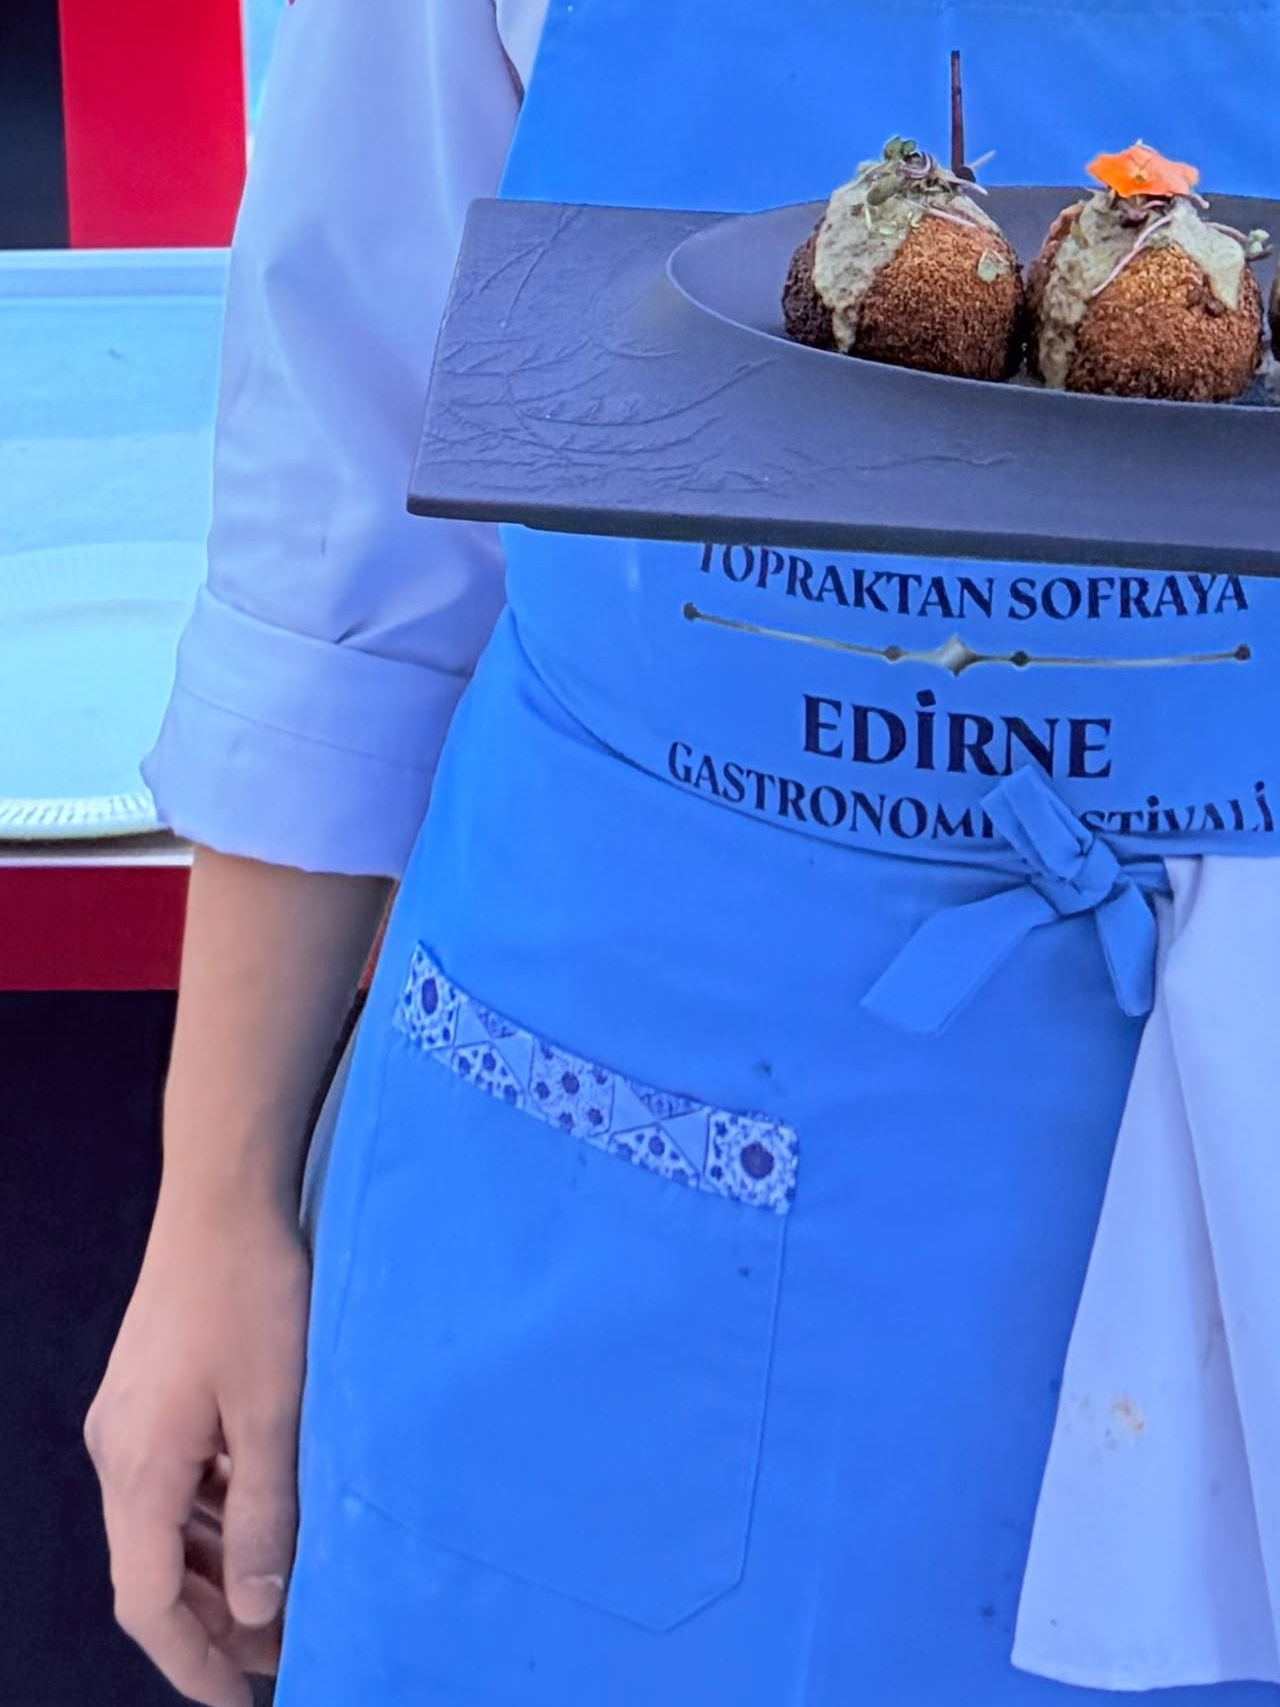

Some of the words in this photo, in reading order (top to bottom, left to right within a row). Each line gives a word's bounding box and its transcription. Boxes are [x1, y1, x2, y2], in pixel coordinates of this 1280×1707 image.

[700, 542, 996, 619] TOPRAKTAN
[1008, 574, 1249, 620] SOFRAYA
[803, 689, 1113, 779] EDİRNE
[1078, 780, 1276, 834] STİVALİ
